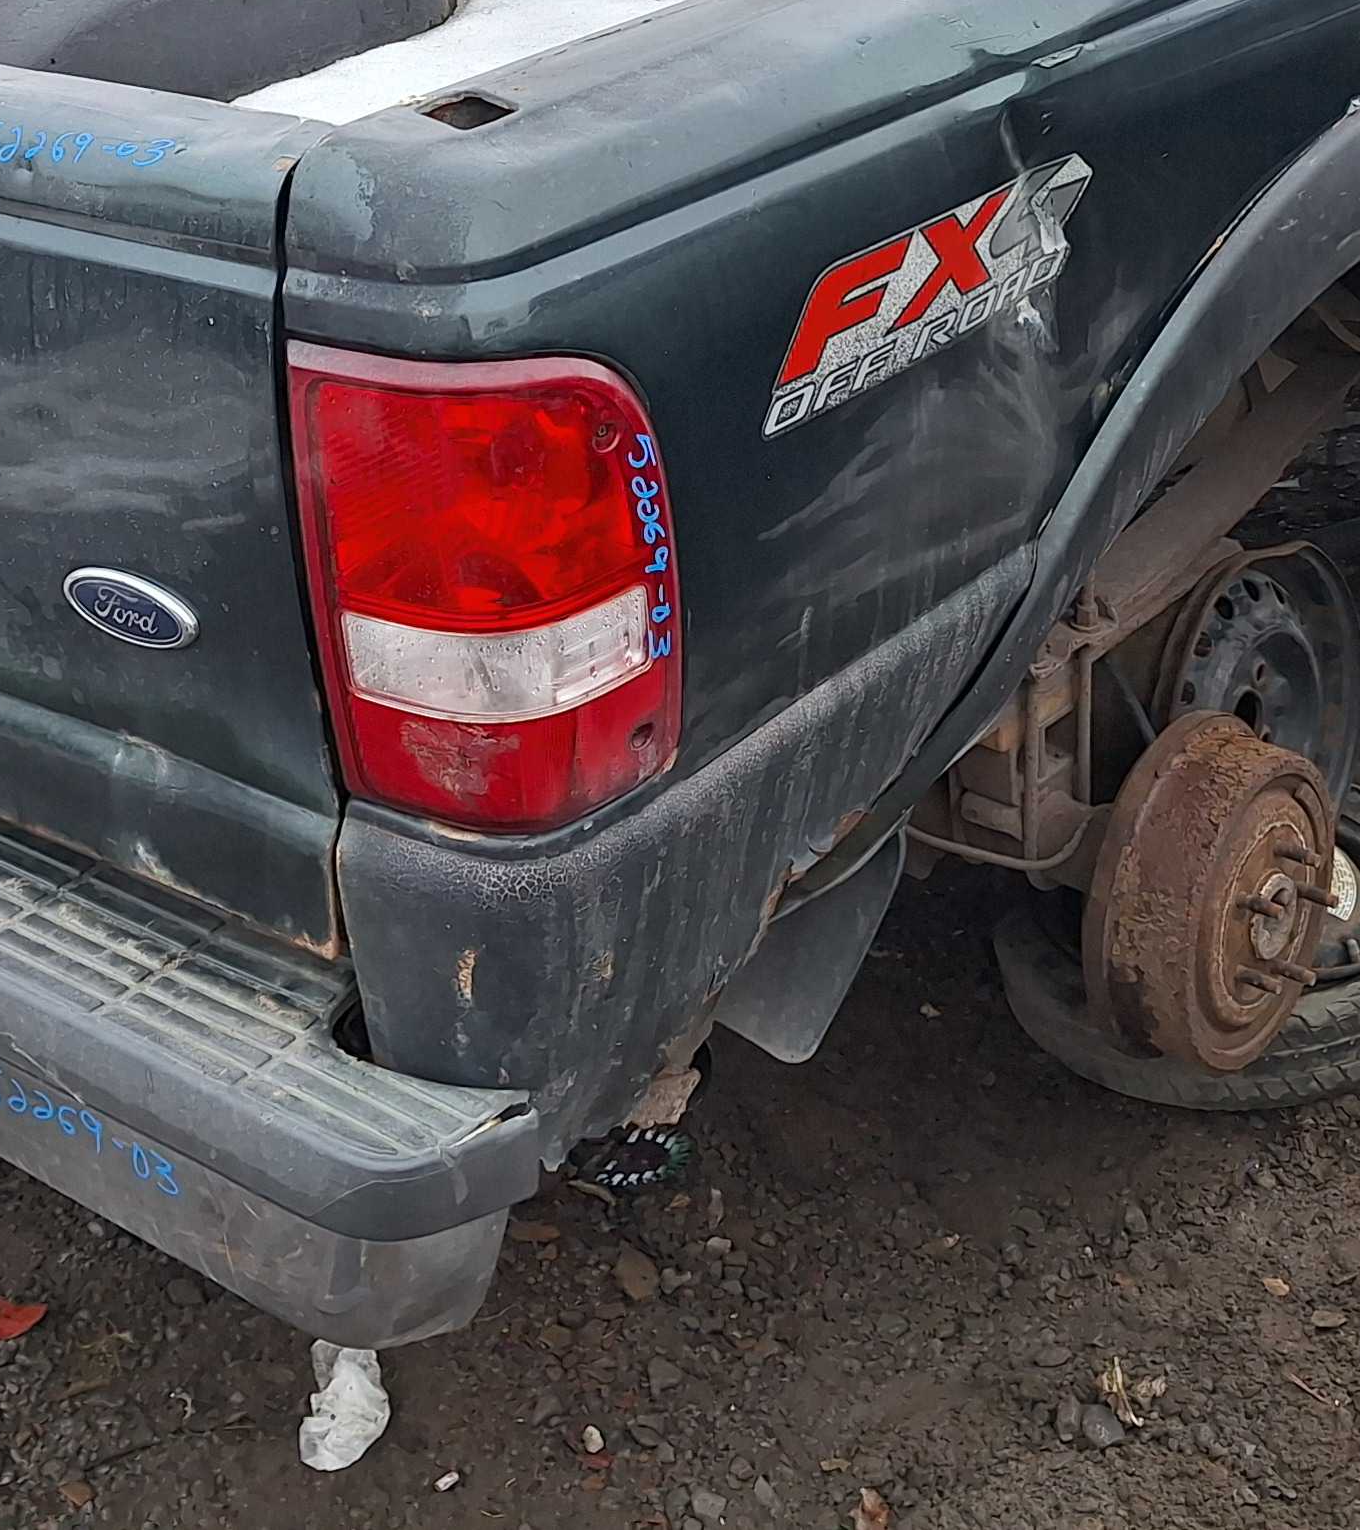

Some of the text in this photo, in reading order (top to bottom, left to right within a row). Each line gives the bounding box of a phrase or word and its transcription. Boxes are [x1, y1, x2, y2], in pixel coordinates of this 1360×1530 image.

[762, 247, 1069, 438] OFF ROAD
[93, 585, 159, 635] Ford
